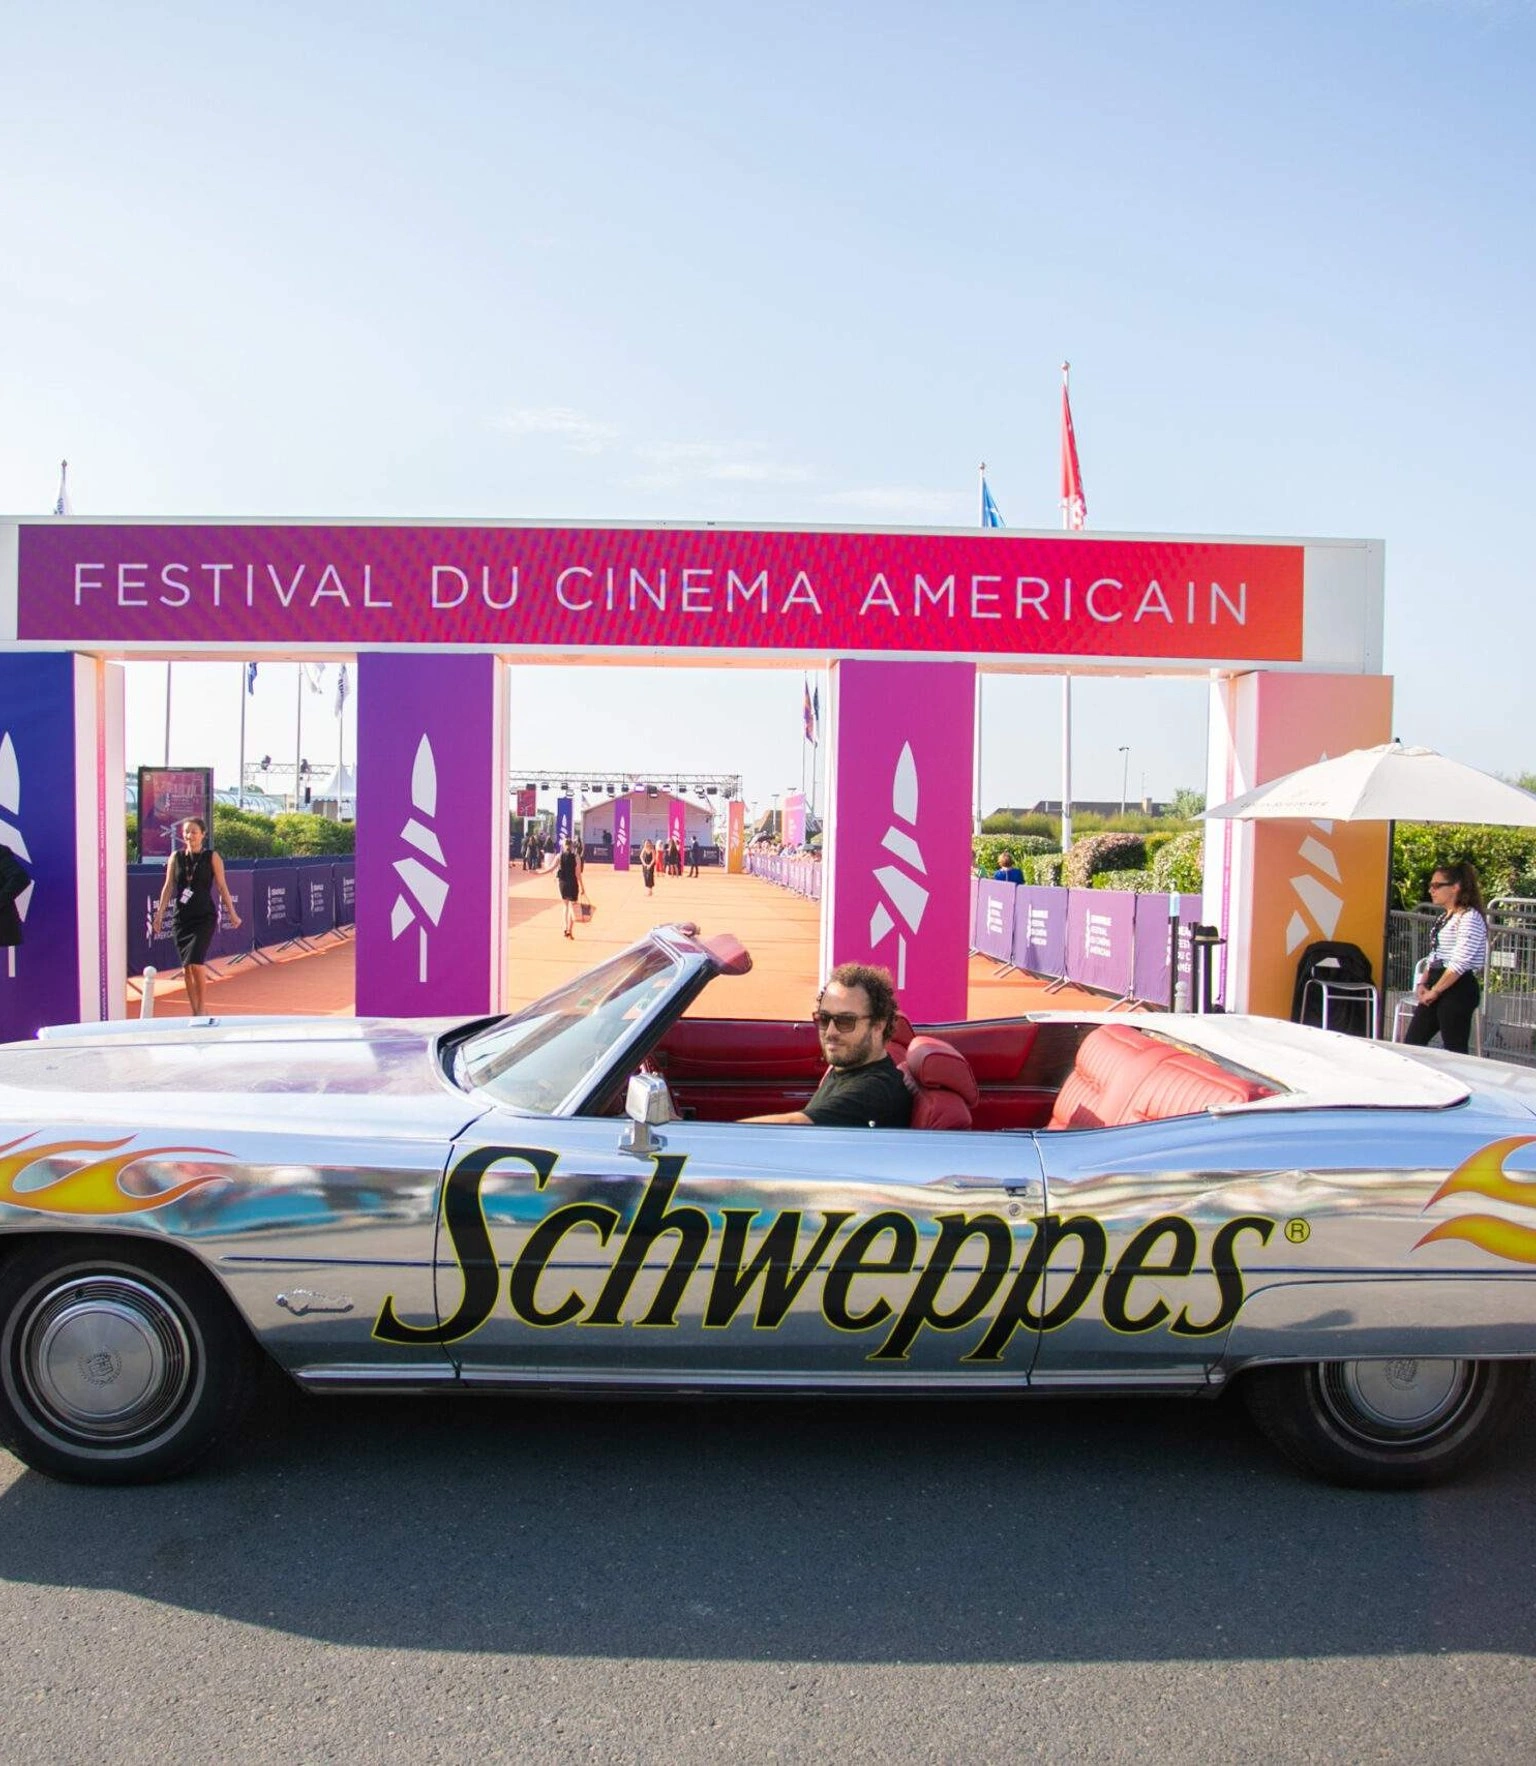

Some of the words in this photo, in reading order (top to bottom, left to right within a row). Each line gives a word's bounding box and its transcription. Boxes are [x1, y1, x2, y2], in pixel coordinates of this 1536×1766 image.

[74, 563, 393, 608] FESTIVAL
[431, 565, 519, 610] DU
[556, 566, 823, 615] CINEMA
[858, 572, 1247, 626] AMERICAIN
[371, 1144, 1276, 1363] Schweppes
